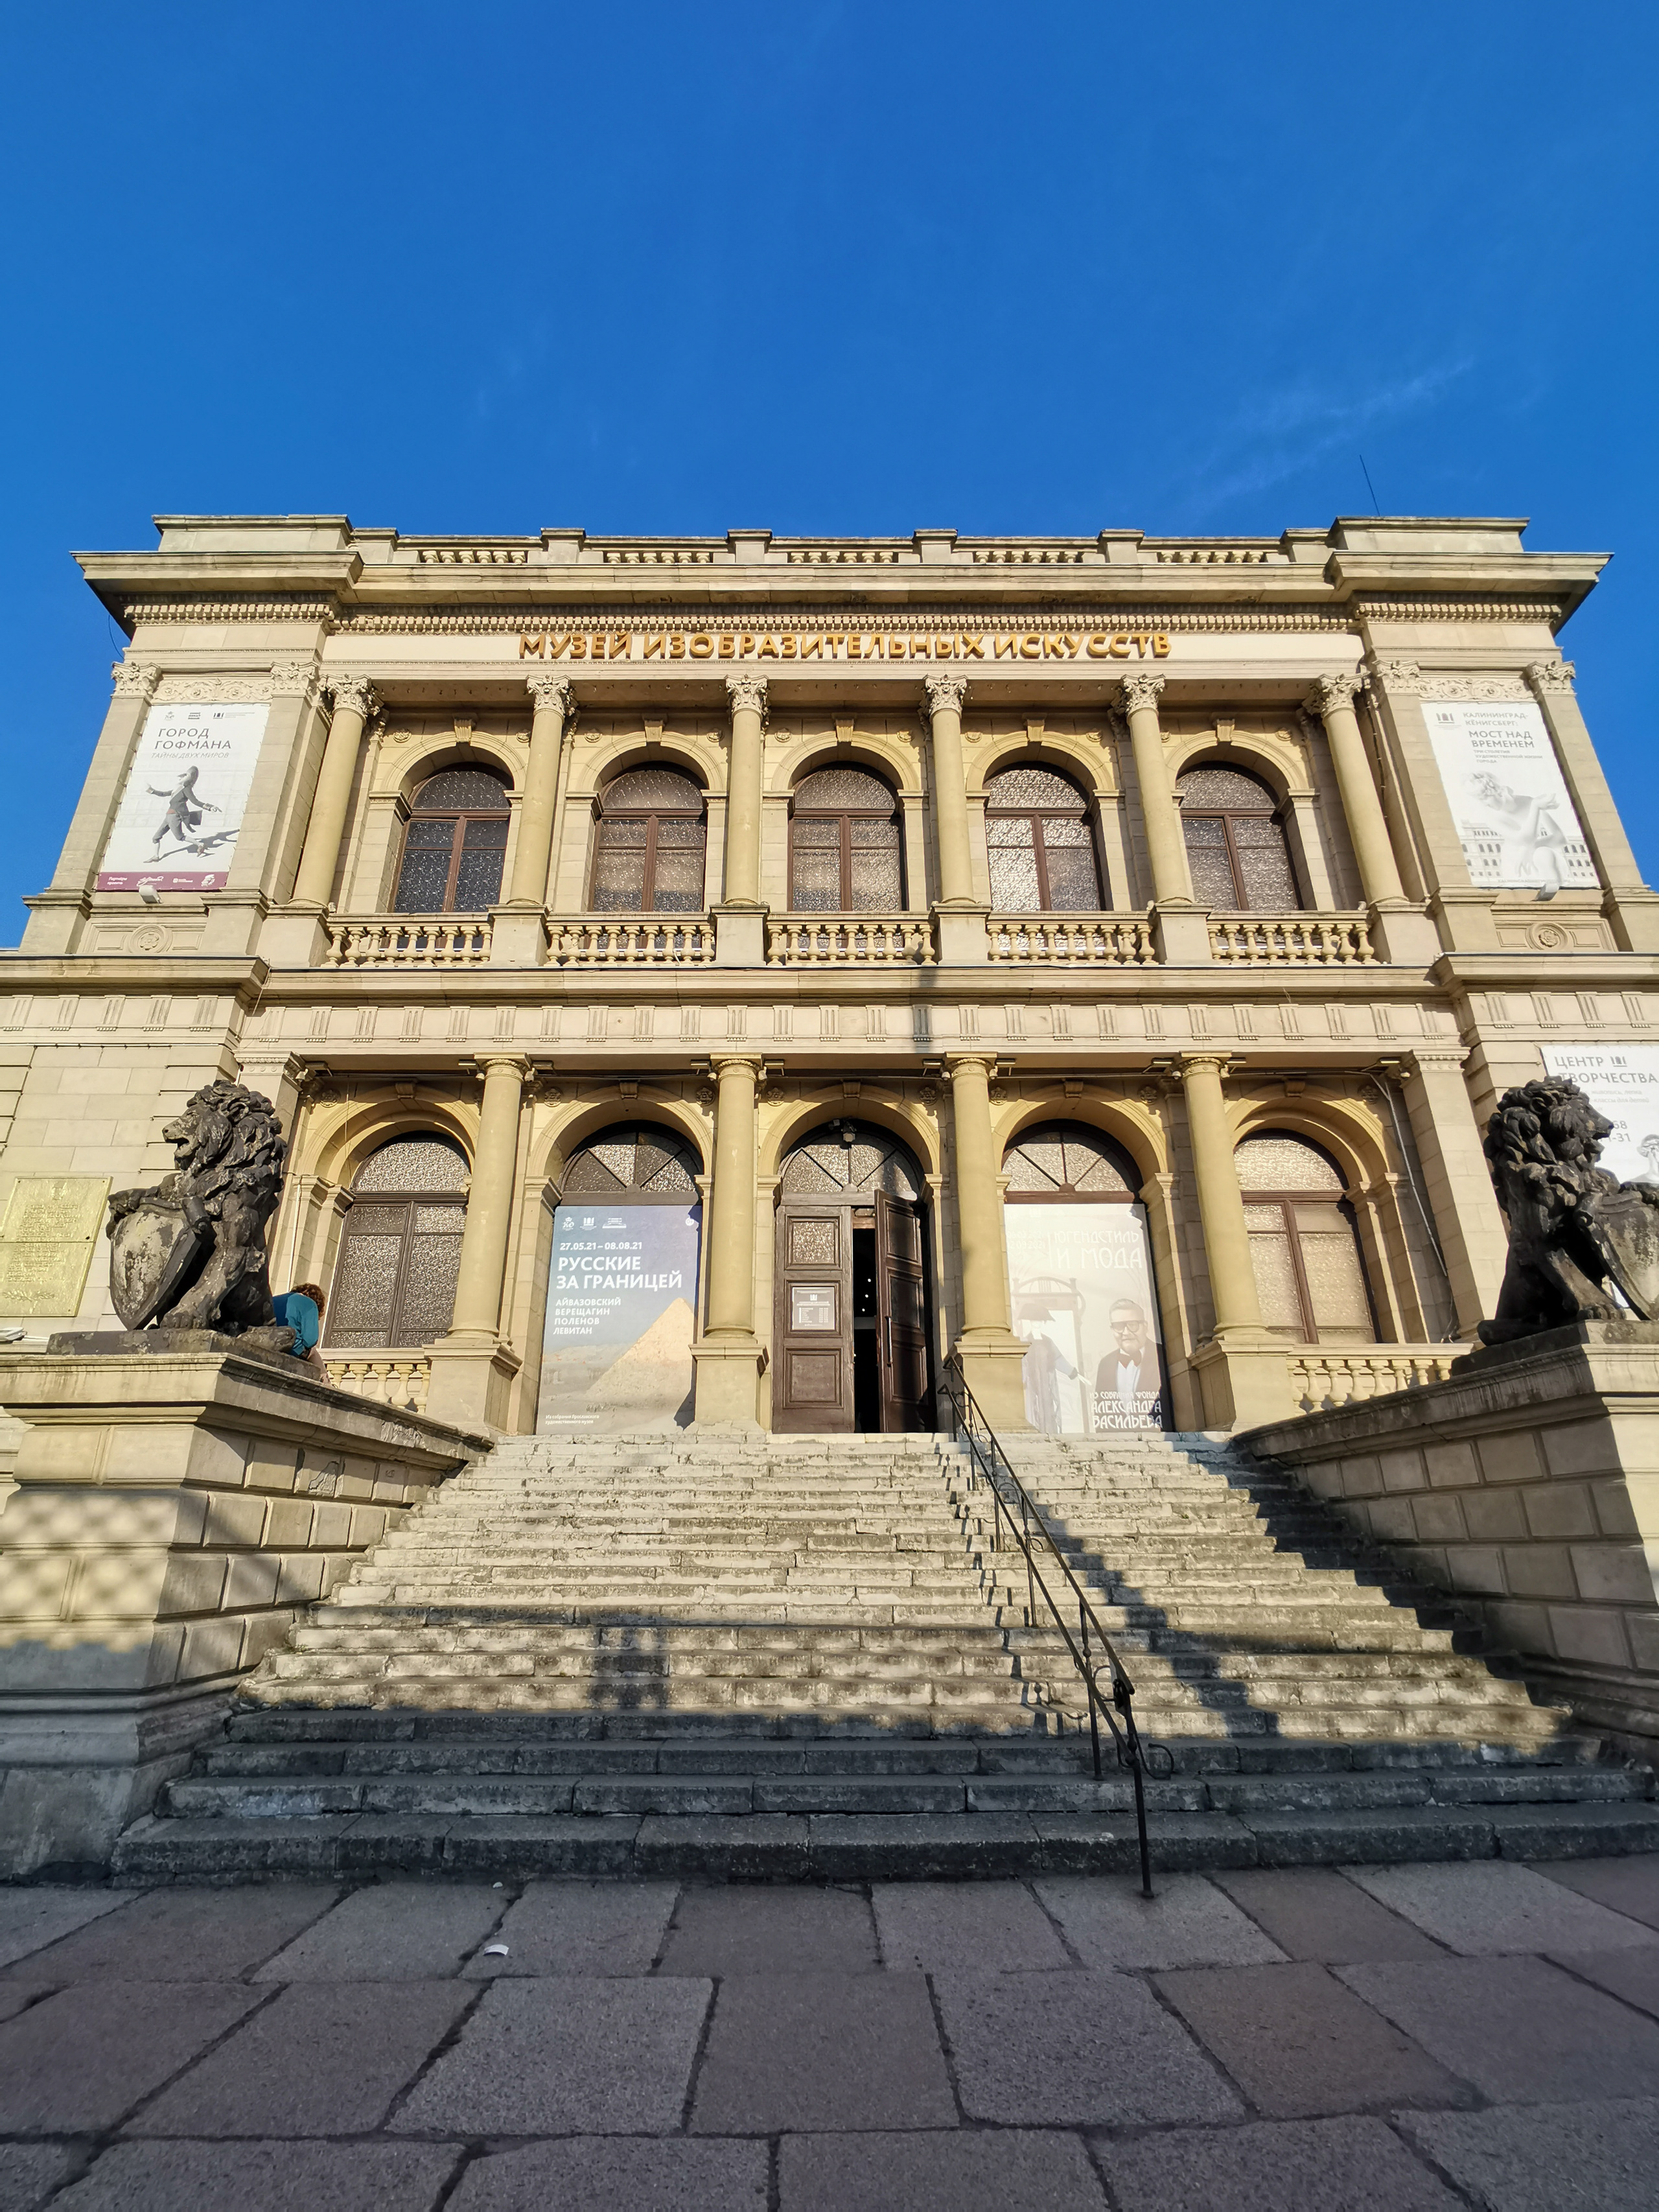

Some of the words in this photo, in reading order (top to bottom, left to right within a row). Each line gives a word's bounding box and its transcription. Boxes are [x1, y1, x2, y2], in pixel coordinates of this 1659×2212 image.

[519, 632, 632, 659] МУЗЕЙ
[644, 633, 984, 659] ИЗОБРАЗИТЕЛЬНЫХ
[993, 633, 1172, 659] ИСКУССТВ
[158, 728, 209, 739] ГОРОД
[1506, 730, 1533, 739] НАД
[155, 740, 231, 749] ГОФМАНА
[1554, 1056, 1604, 1069] ЦЕНТР
[1054, 1230, 1139, 1244] ЮГЕНДСТИЛЬ
[558, 1256, 641, 1271] РУССКИЕ
[1056, 1247, 1071, 1269] И
[1081, 1247, 1143, 1269] МОДА
[556, 1275, 579, 1289] ЗА
[584, 1270, 682, 1292] ГРАНИЦЕЙ
[555, 1297, 621, 1307] АЙВАЗОВСКИЙ
[555, 1308, 610, 1316] ВЕРЕЩАГИН
[1091, 1400, 1163, 1414] АЛЕКСАНДРА
[1093, 1415, 1163, 1428] ВАСИЛЬЕВА
